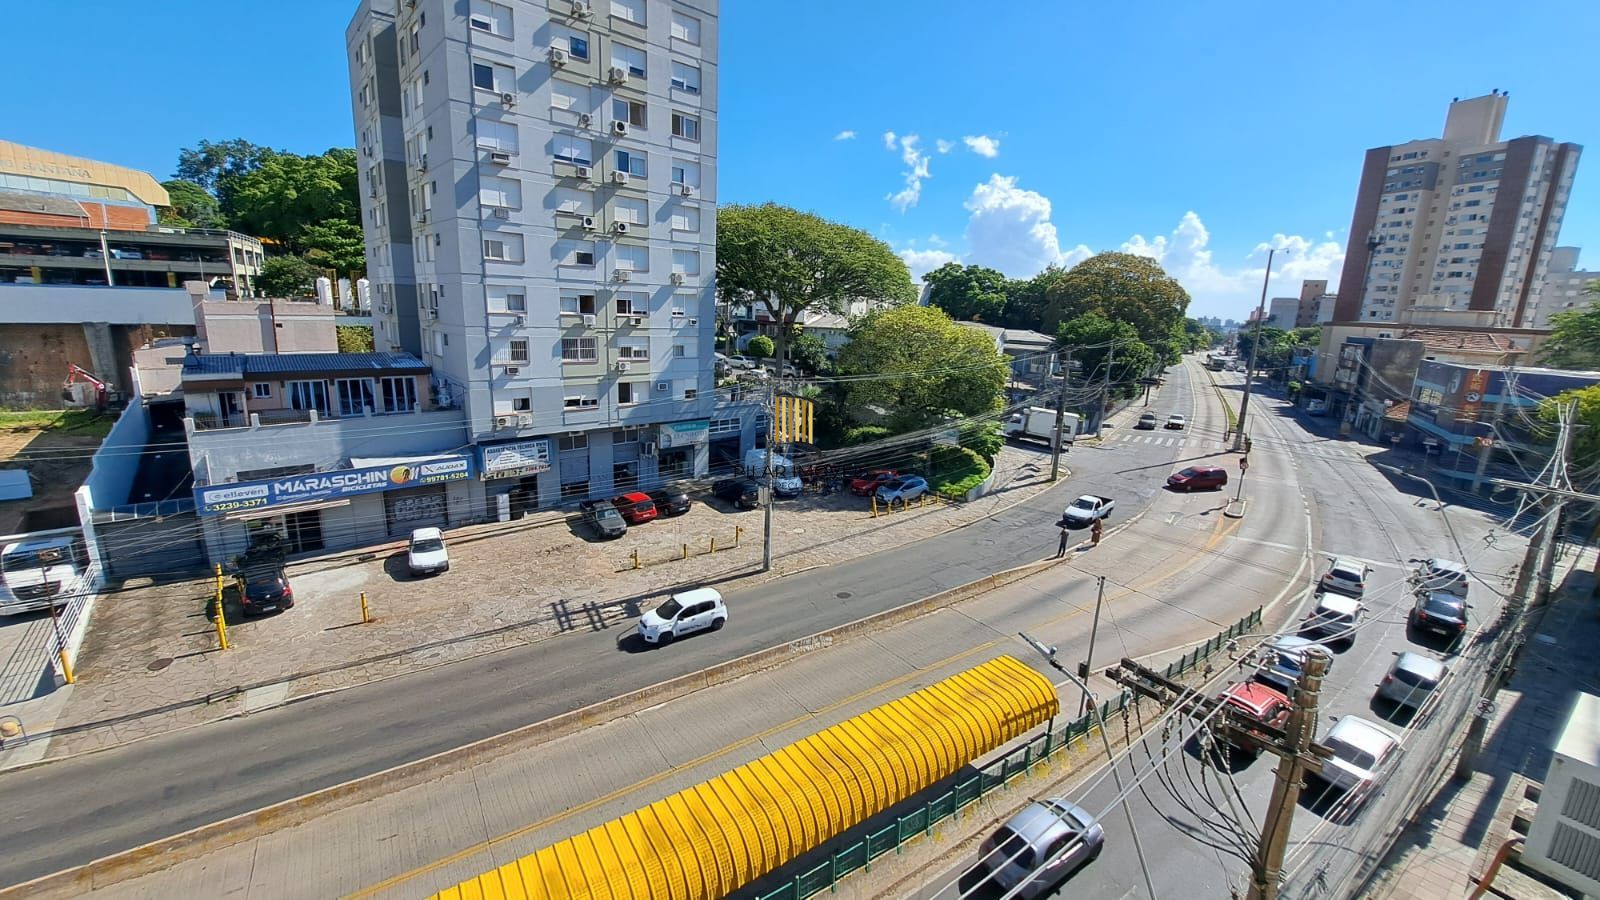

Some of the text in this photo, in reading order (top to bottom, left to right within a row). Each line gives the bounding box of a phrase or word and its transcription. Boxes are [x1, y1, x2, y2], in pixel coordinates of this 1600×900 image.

[273, 470, 388, 495] MARASCHIN
[341, 482, 388, 493] BICICLETAS
[223, 487, 264, 500] elleven
[212, 497, 267, 512] 3239-3371
